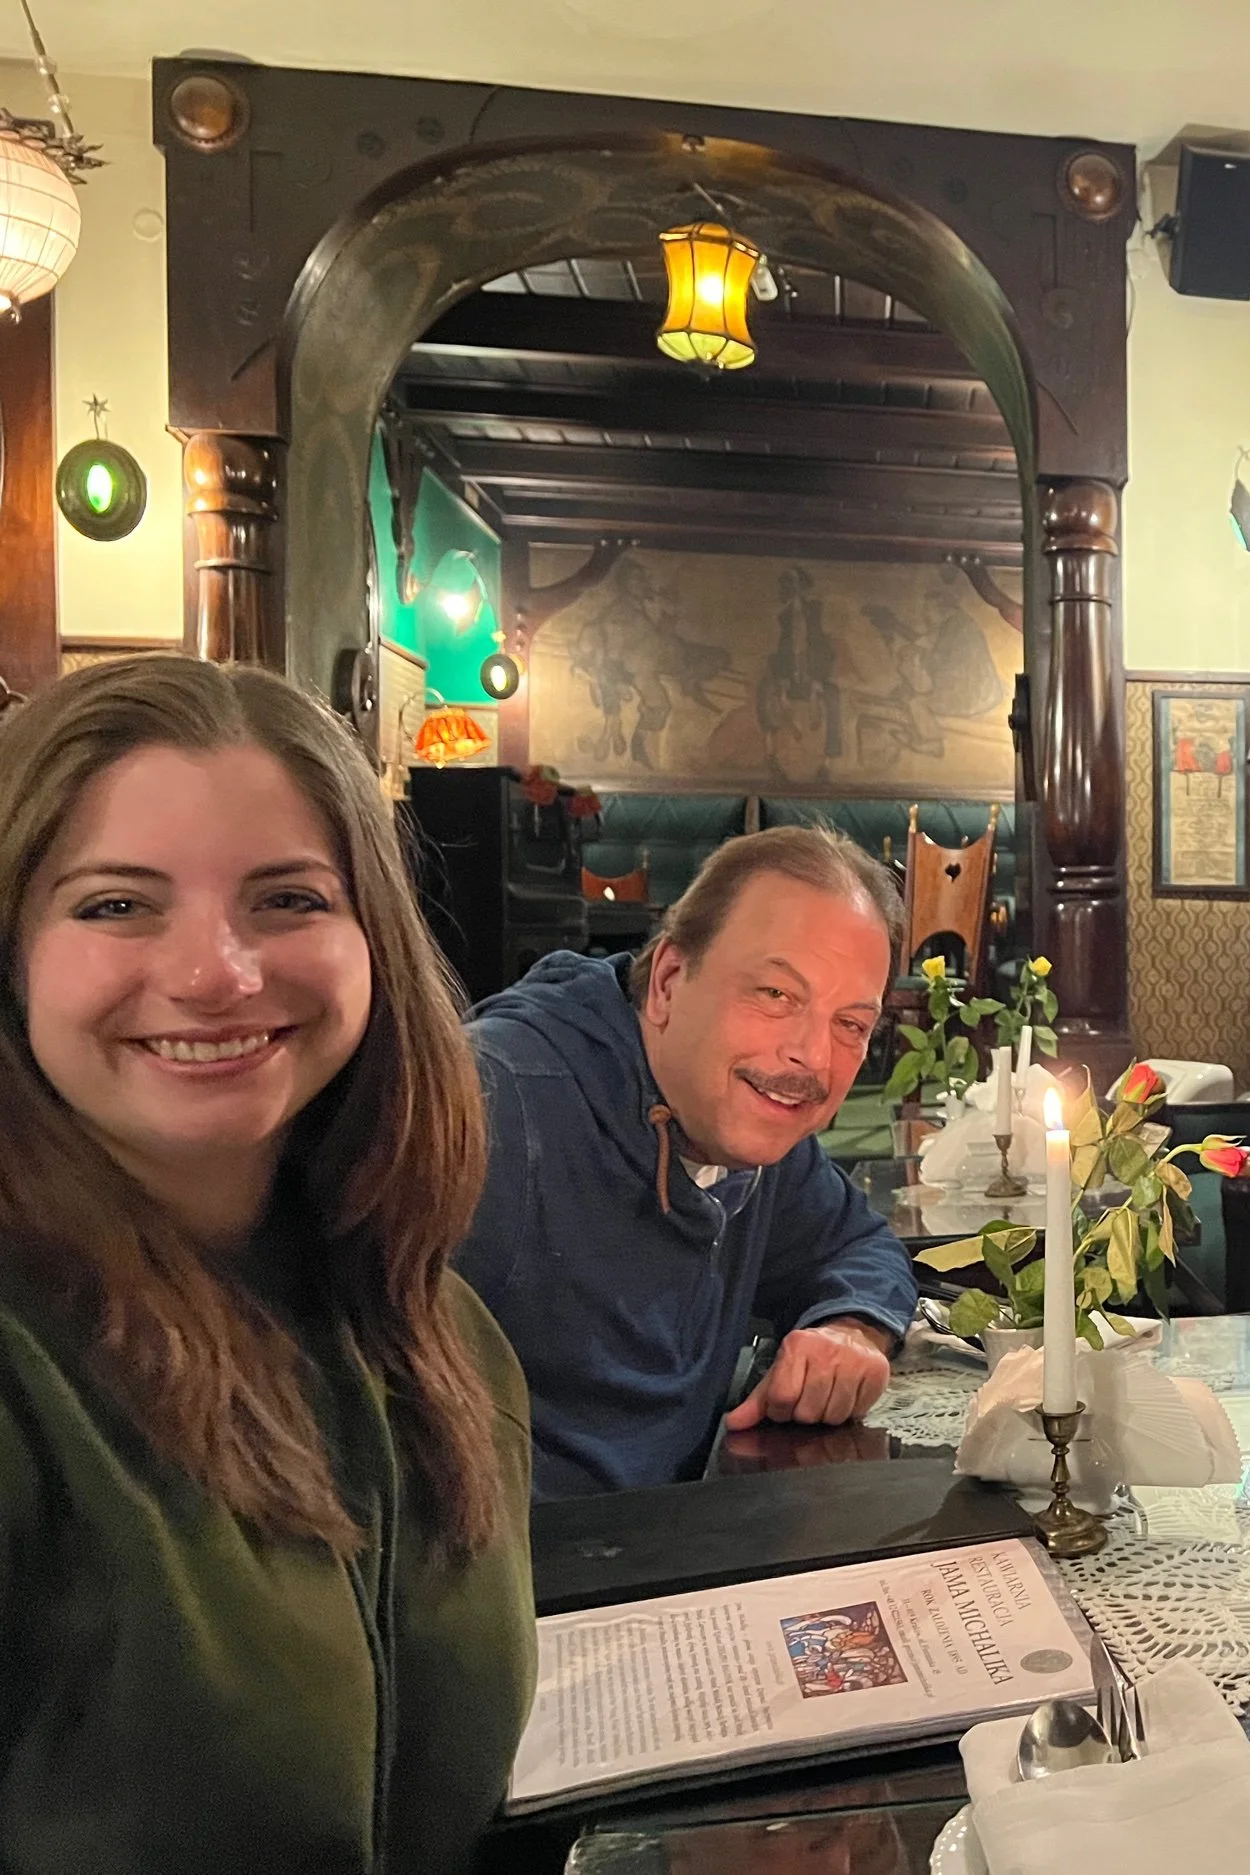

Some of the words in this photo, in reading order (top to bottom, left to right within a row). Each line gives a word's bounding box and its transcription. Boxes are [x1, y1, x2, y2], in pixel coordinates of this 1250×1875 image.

[922, 1588, 934, 1606] ROK
[968, 1557, 1014, 1627] RESTAURACJA
[992, 1552, 1031, 1610] KAWIARNIA
[931, 1561, 969, 1599] JAMA
[955, 1600, 1014, 1685] MICHALIKA
